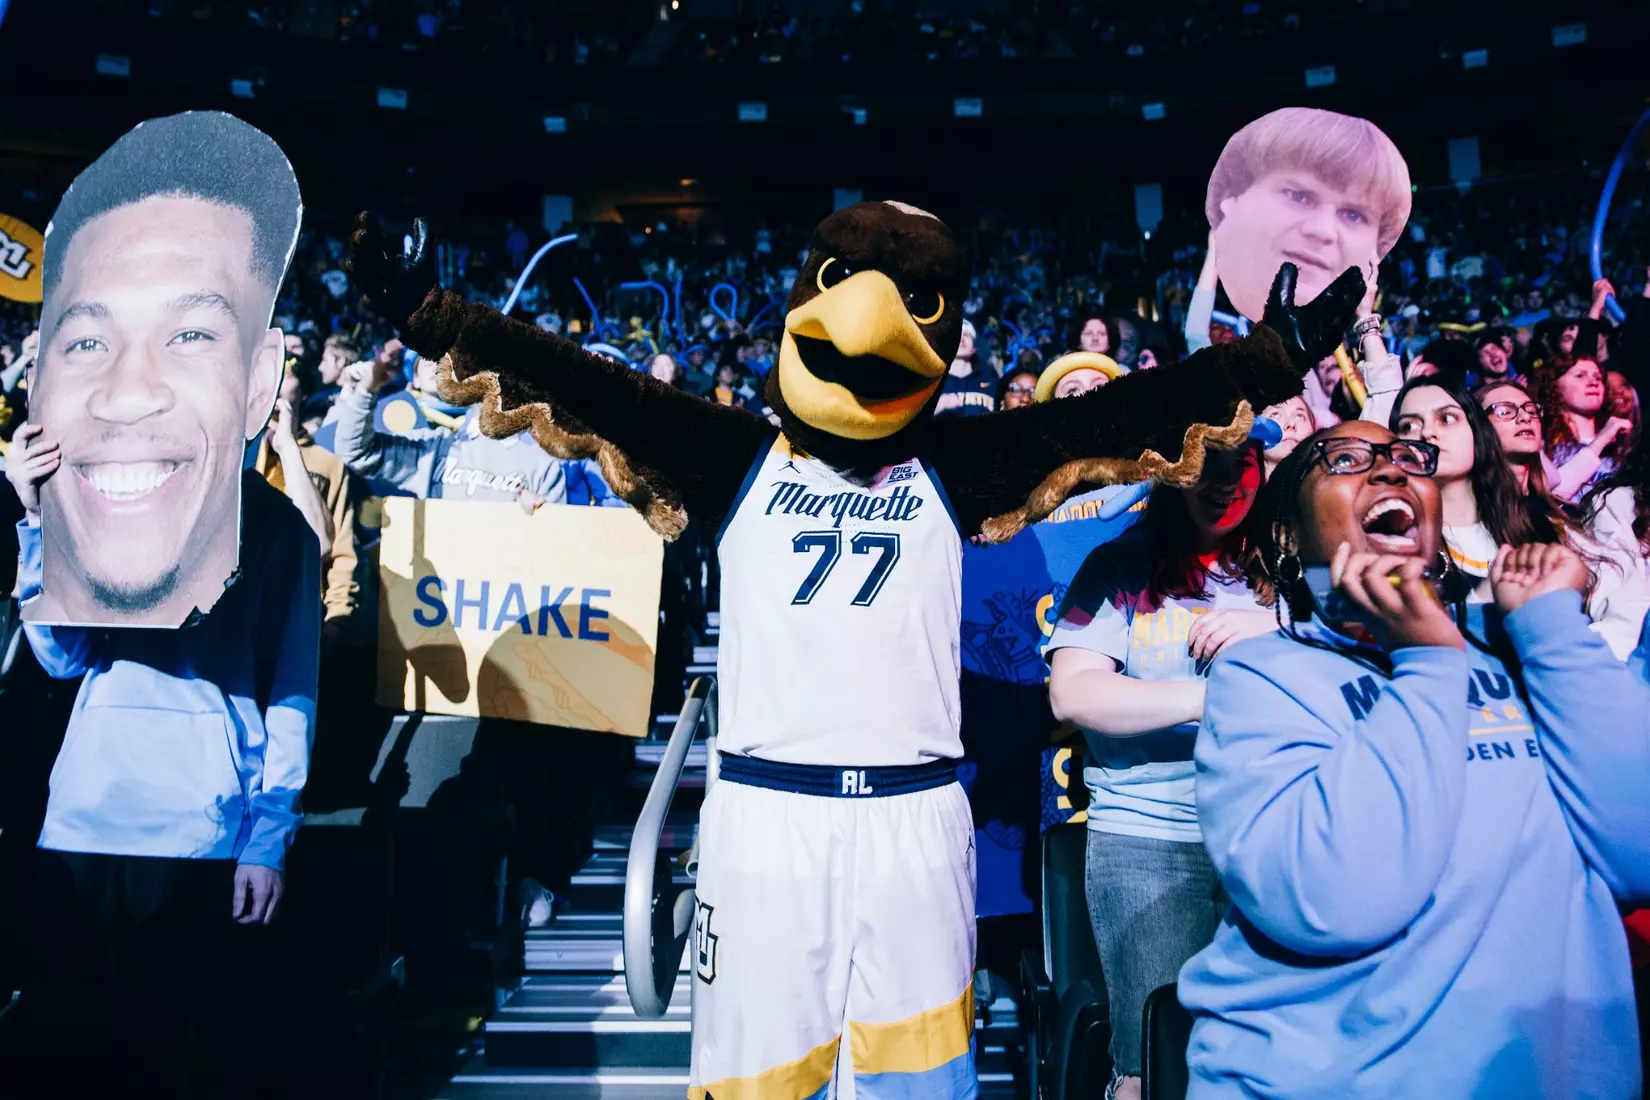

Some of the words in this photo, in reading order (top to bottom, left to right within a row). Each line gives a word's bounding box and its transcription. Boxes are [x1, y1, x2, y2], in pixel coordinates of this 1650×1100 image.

[889, 472, 918, 480] EAST
[765, 481, 923, 528] Marquette
[790, 530, 900, 607] 77
[413, 575, 611, 642] SHAKE
[841, 770, 873, 795] AL
